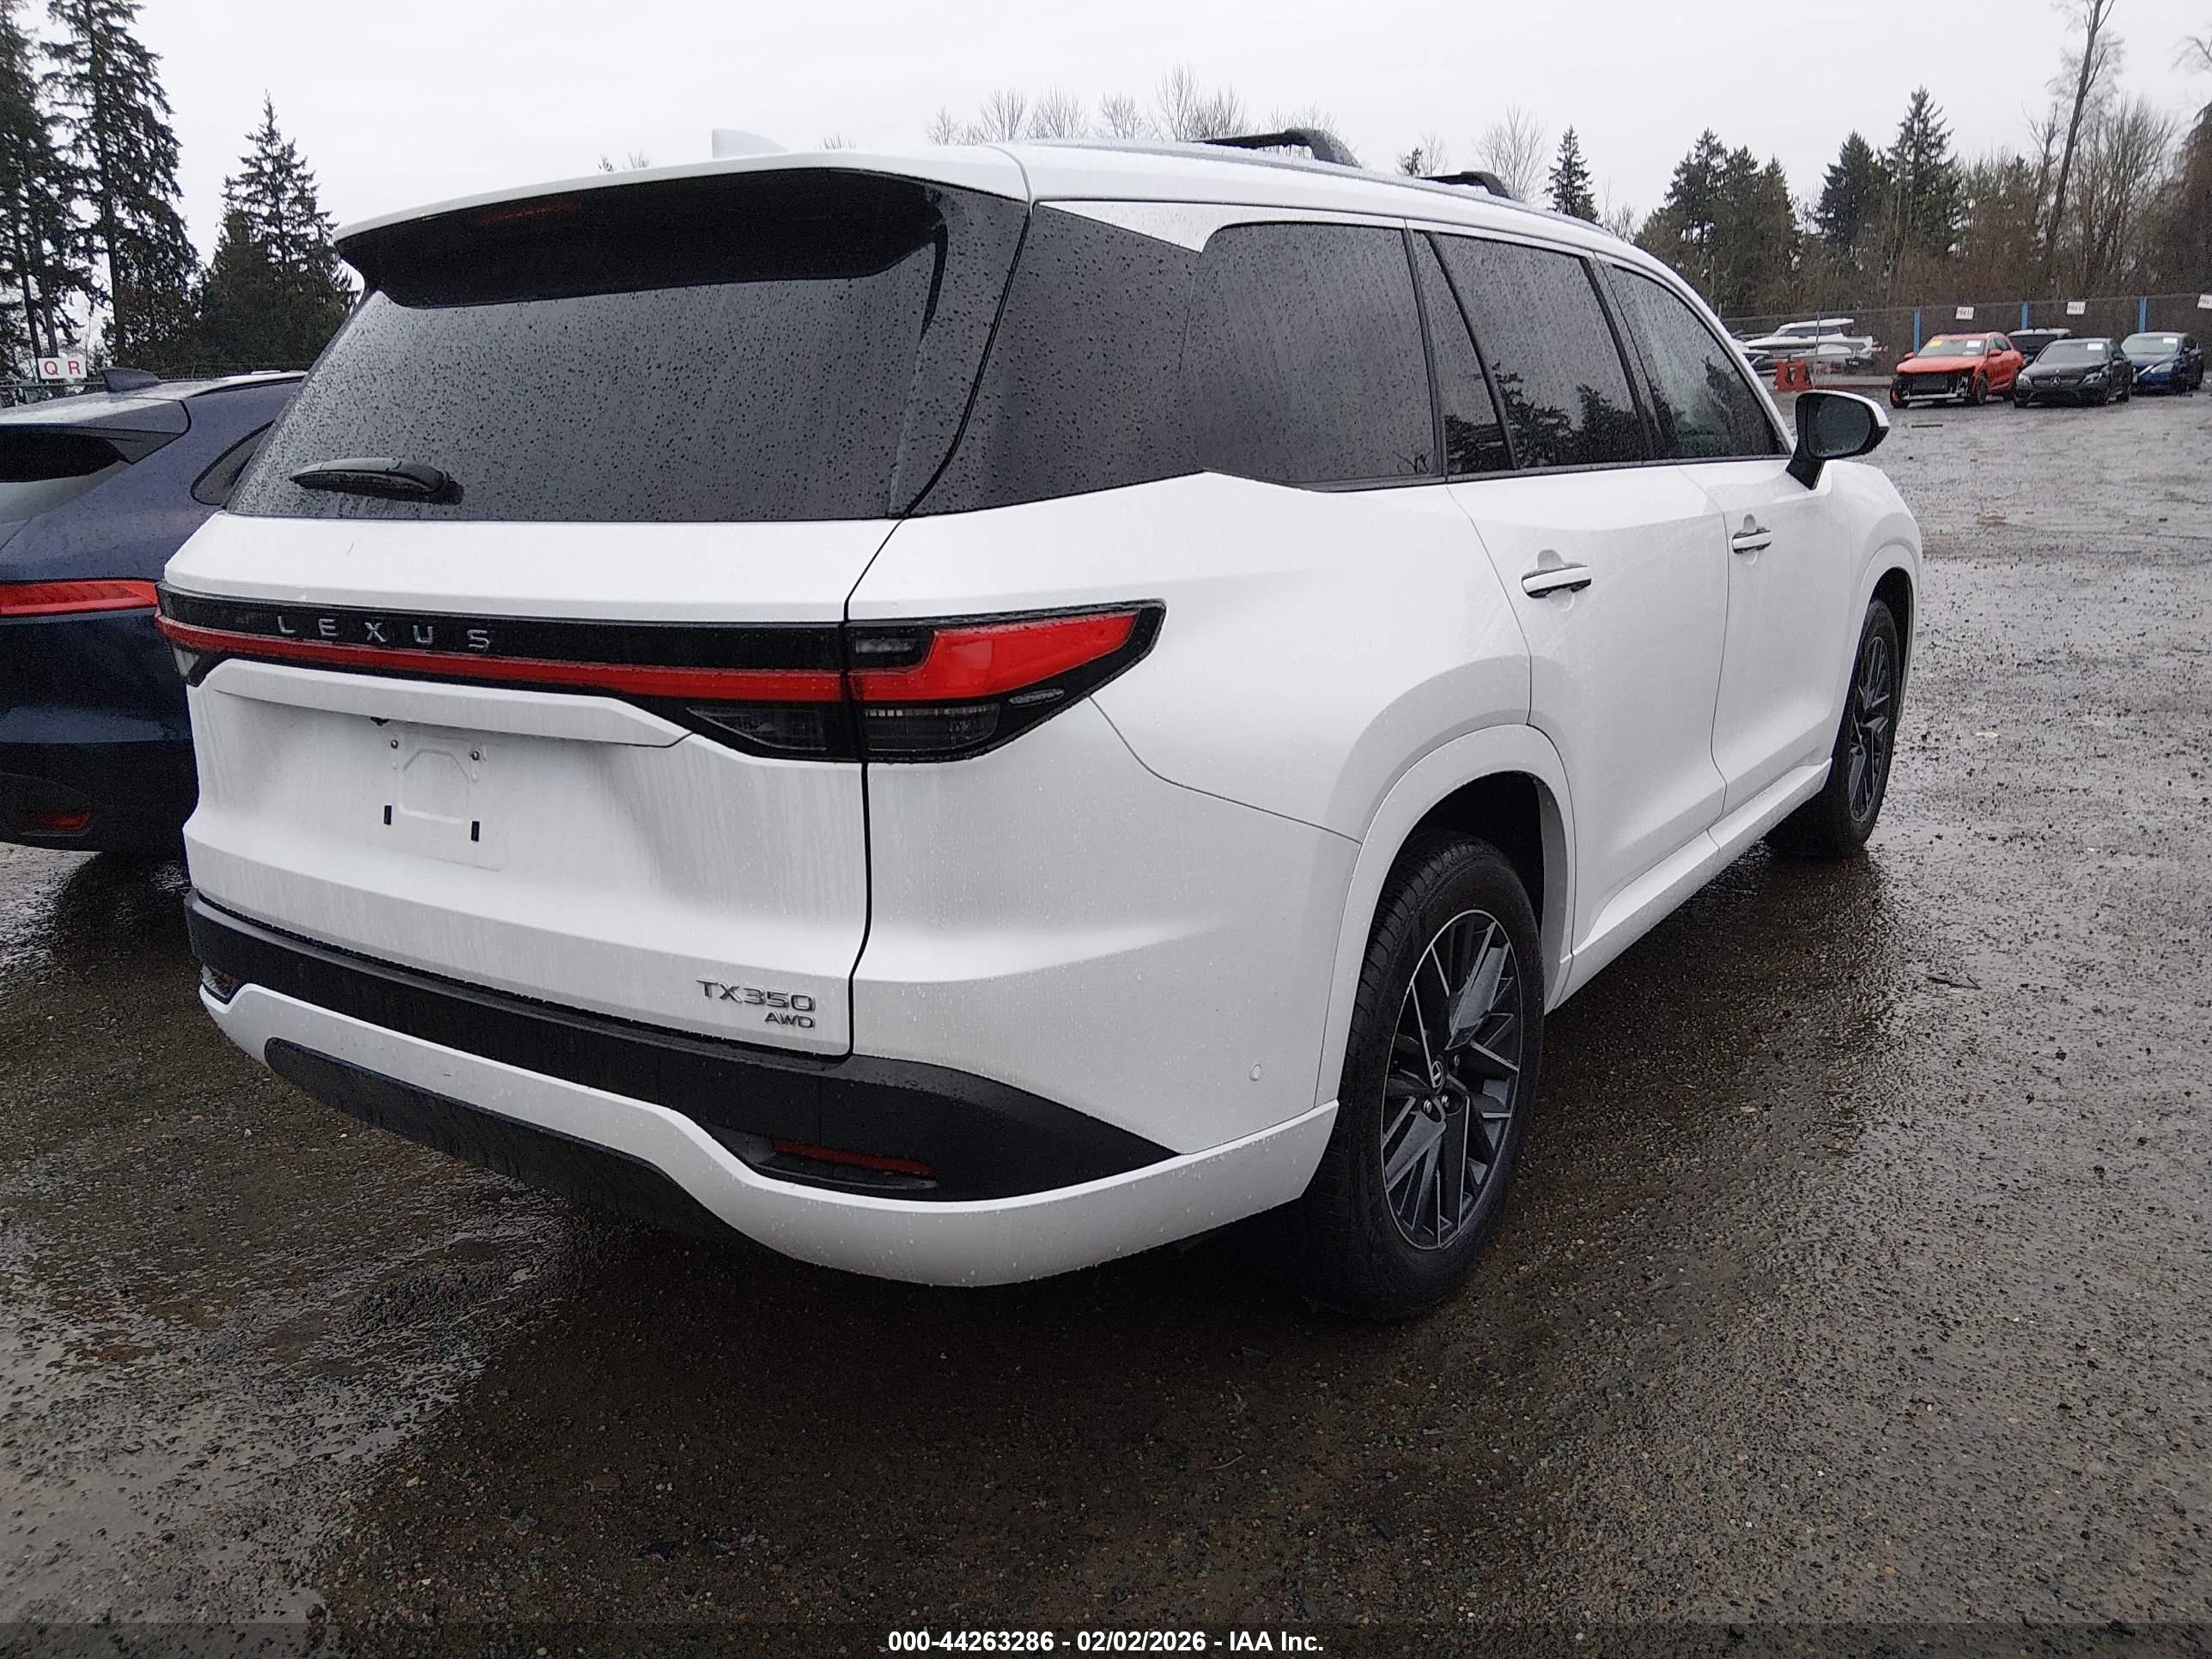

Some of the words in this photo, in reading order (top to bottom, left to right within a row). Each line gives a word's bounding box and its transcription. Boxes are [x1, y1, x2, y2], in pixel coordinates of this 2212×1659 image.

[44, 361, 58, 375] Q
[68, 361, 81, 374] R
[277, 615, 490, 649] LEXUS
[696, 977, 816, 1012] TX350
[764, 1012, 816, 1029] AWD
